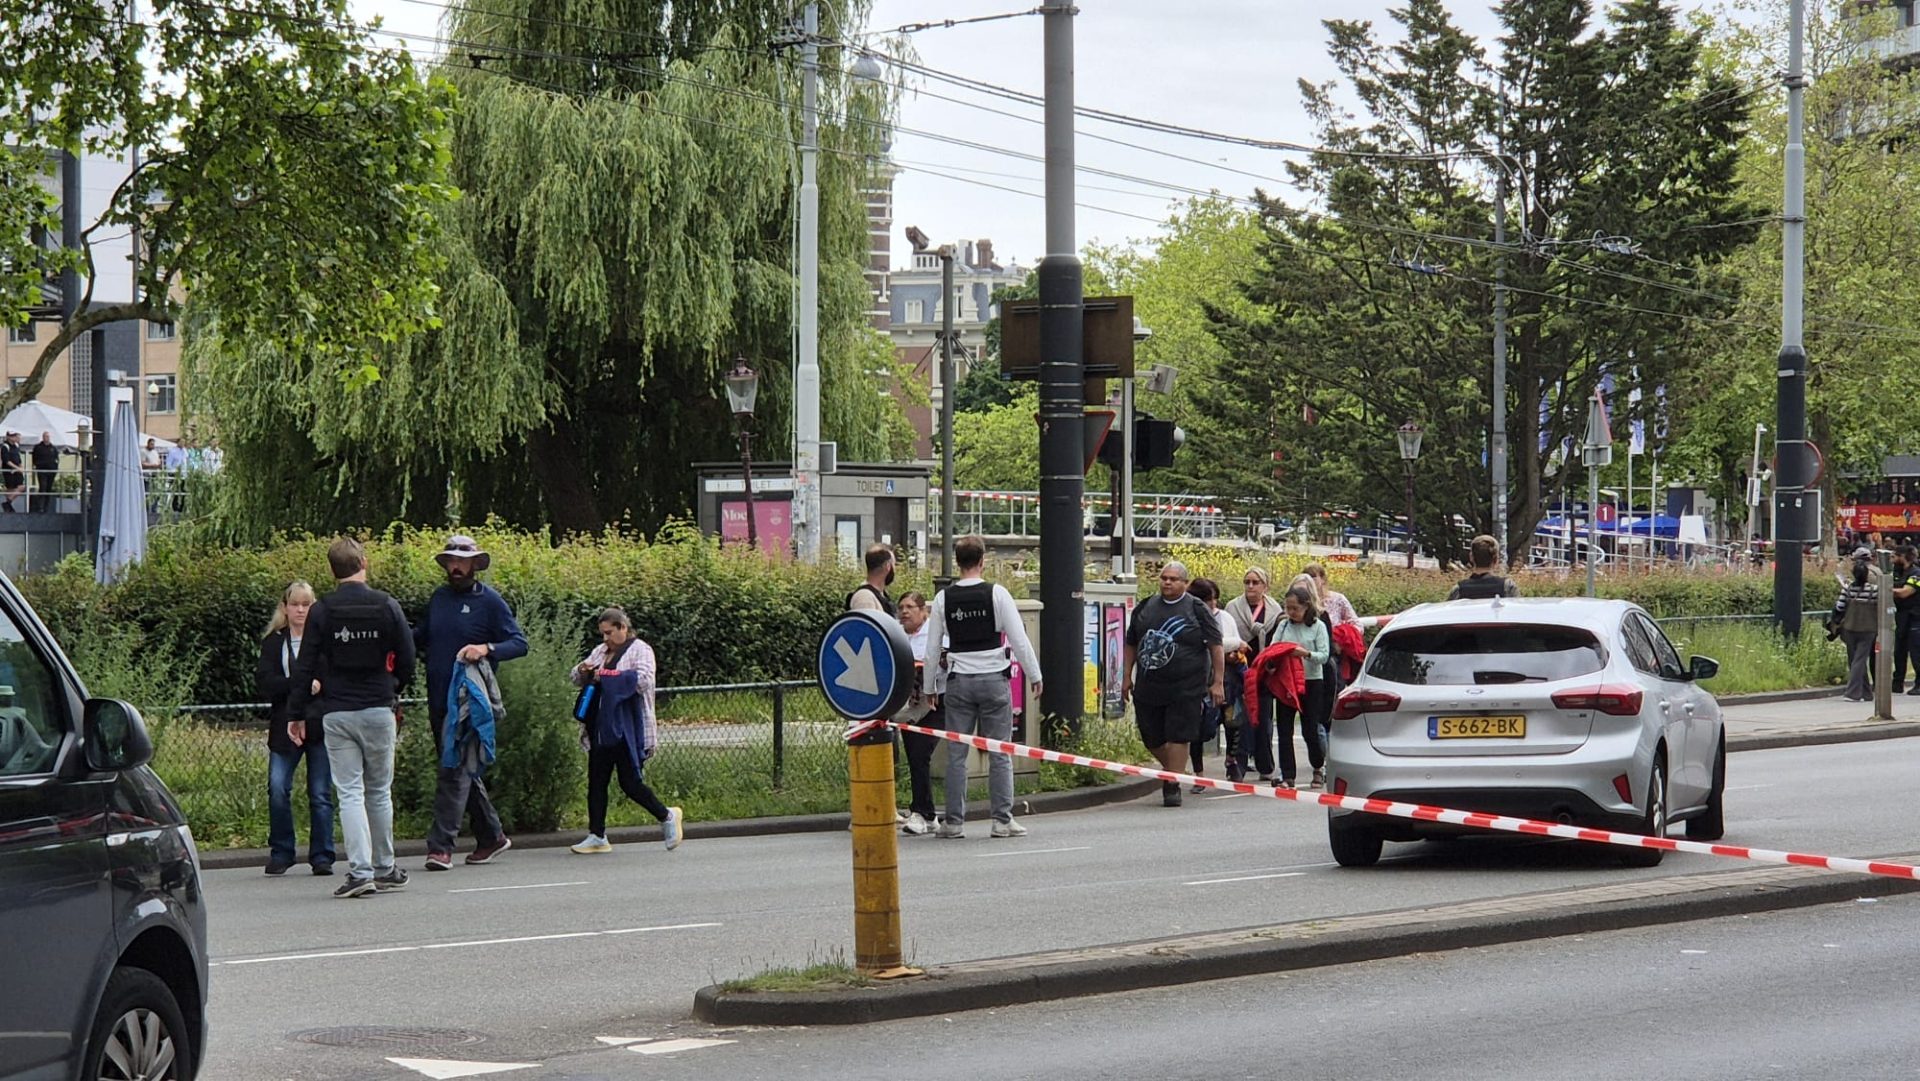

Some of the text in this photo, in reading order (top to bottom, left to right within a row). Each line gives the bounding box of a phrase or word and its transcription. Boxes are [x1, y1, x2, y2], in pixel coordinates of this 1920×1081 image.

[739, 480, 771, 490] TILET
[857, 480, 884, 493] TOILET
[1601, 506, 1608, 521] 1
[951, 608, 987, 621] POLITIE
[334, 626, 379, 642] POLITIE
[1442, 718, 1519, 734] S-662-BK
